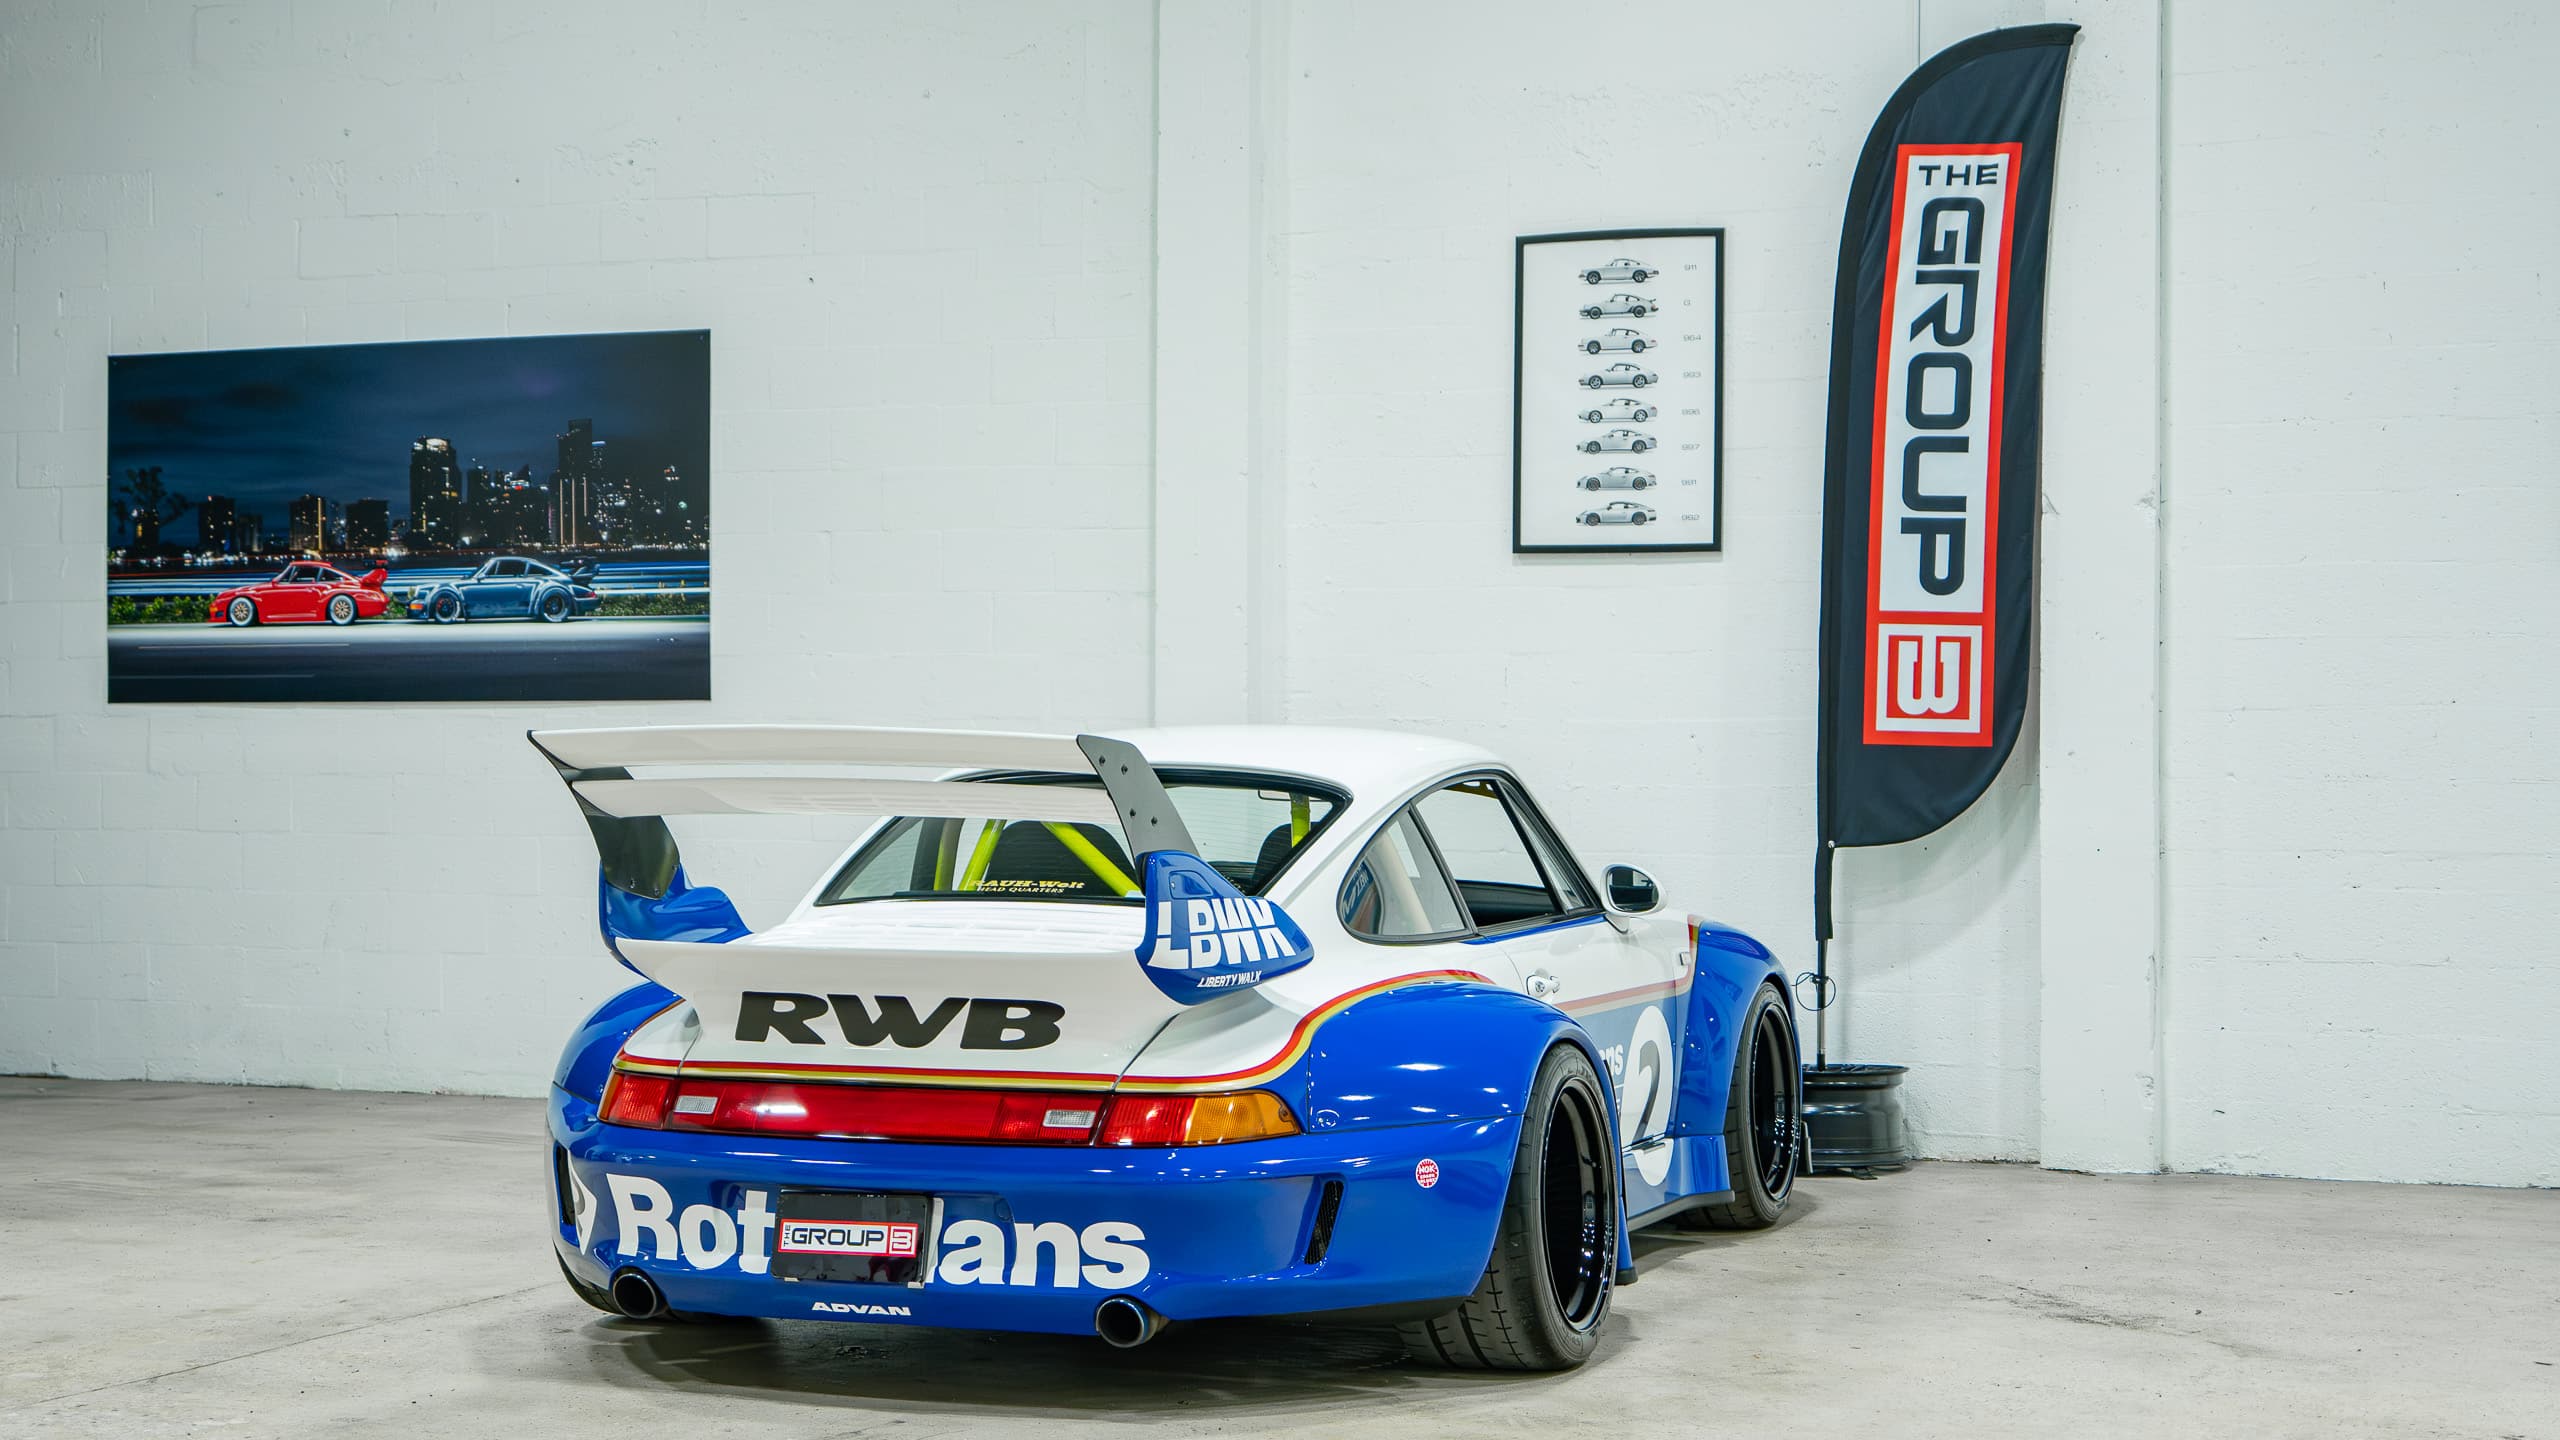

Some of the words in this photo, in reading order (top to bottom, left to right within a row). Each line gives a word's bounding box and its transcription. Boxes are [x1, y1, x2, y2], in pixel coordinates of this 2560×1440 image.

[1919, 163, 1999, 186] THE
[1900, 197, 1985, 597] GROUP
[1196, 973, 1239, 988] LIBERTY
[1237, 970, 1263, 985] WALK
[734, 990, 1066, 1050] RWB
[605, 1173, 1151, 1289] Rotans
[783, 1224, 791, 1247] THE
[791, 1227, 885, 1247] GROUP
[811, 1301, 912, 1316] ADVAN
